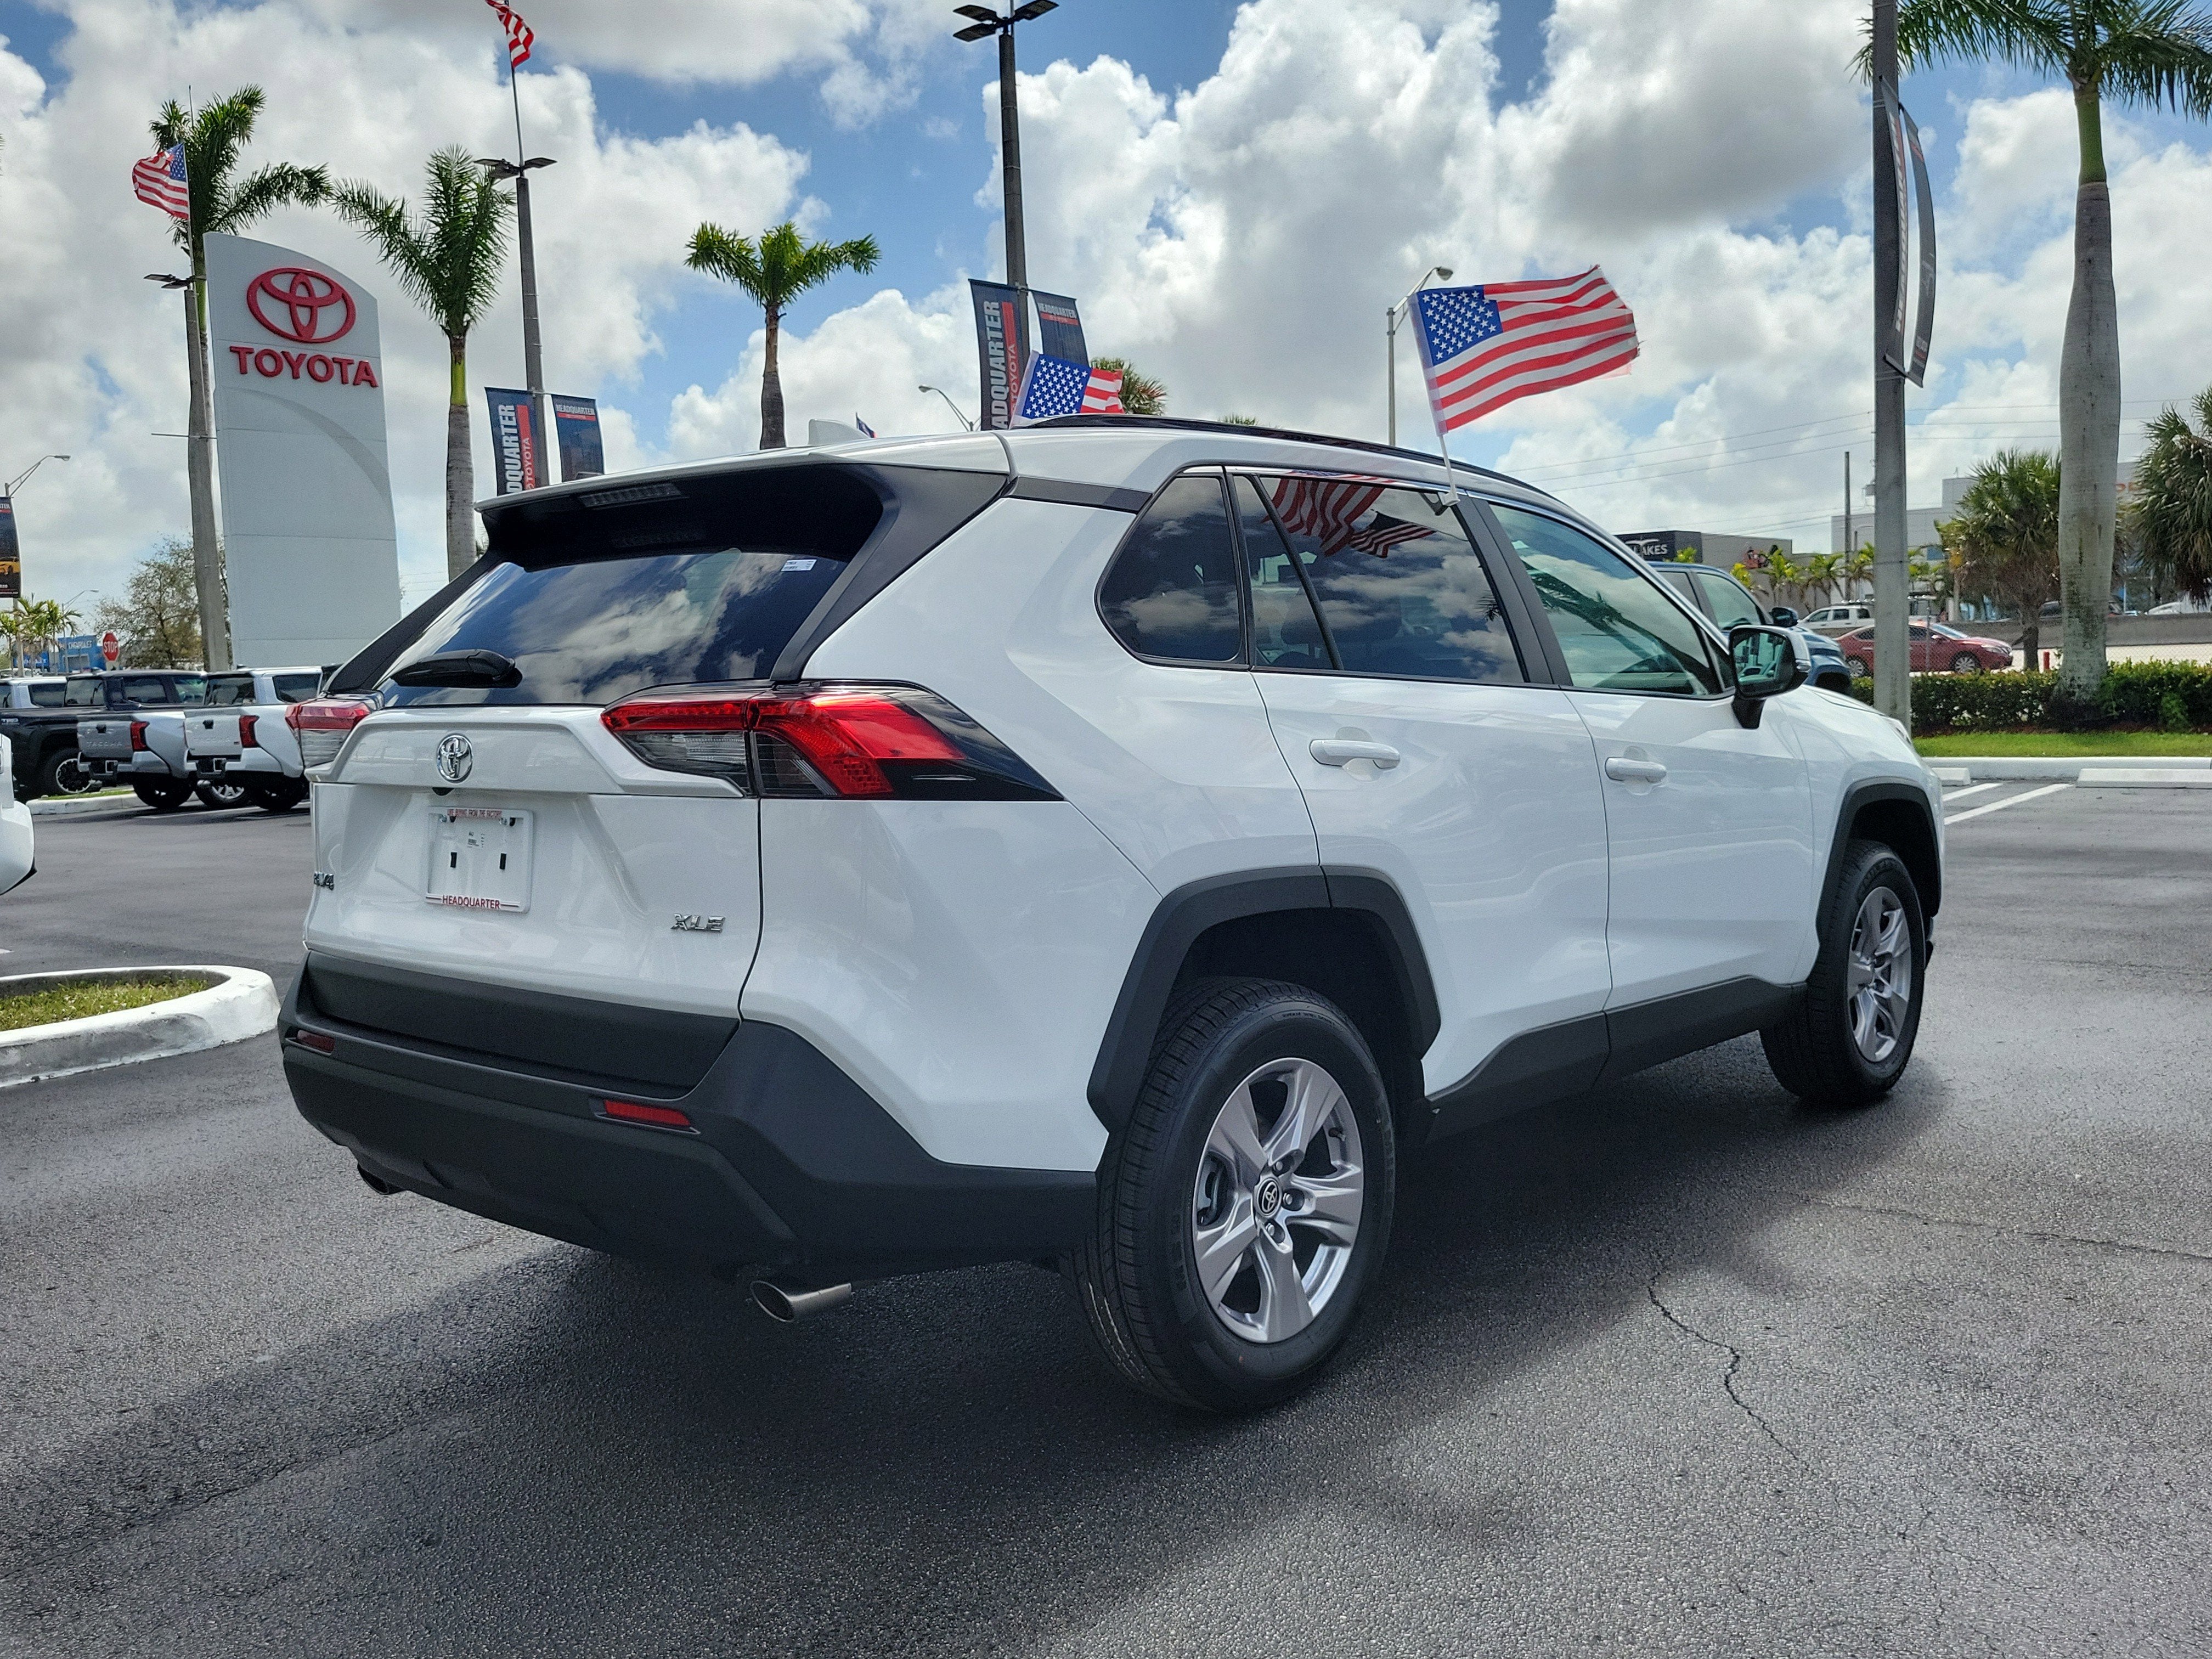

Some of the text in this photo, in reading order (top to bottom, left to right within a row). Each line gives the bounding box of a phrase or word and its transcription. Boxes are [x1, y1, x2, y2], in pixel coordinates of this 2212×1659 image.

[229, 346, 379, 388] TOYOTA
[1007, 343, 1019, 402] TOYOTA
[523, 437, 533, 481] TOYOTA
[104, 641, 119, 653] STOP
[442, 895, 500, 909] HEADQUARTER
[670, 913, 726, 933] XLE
